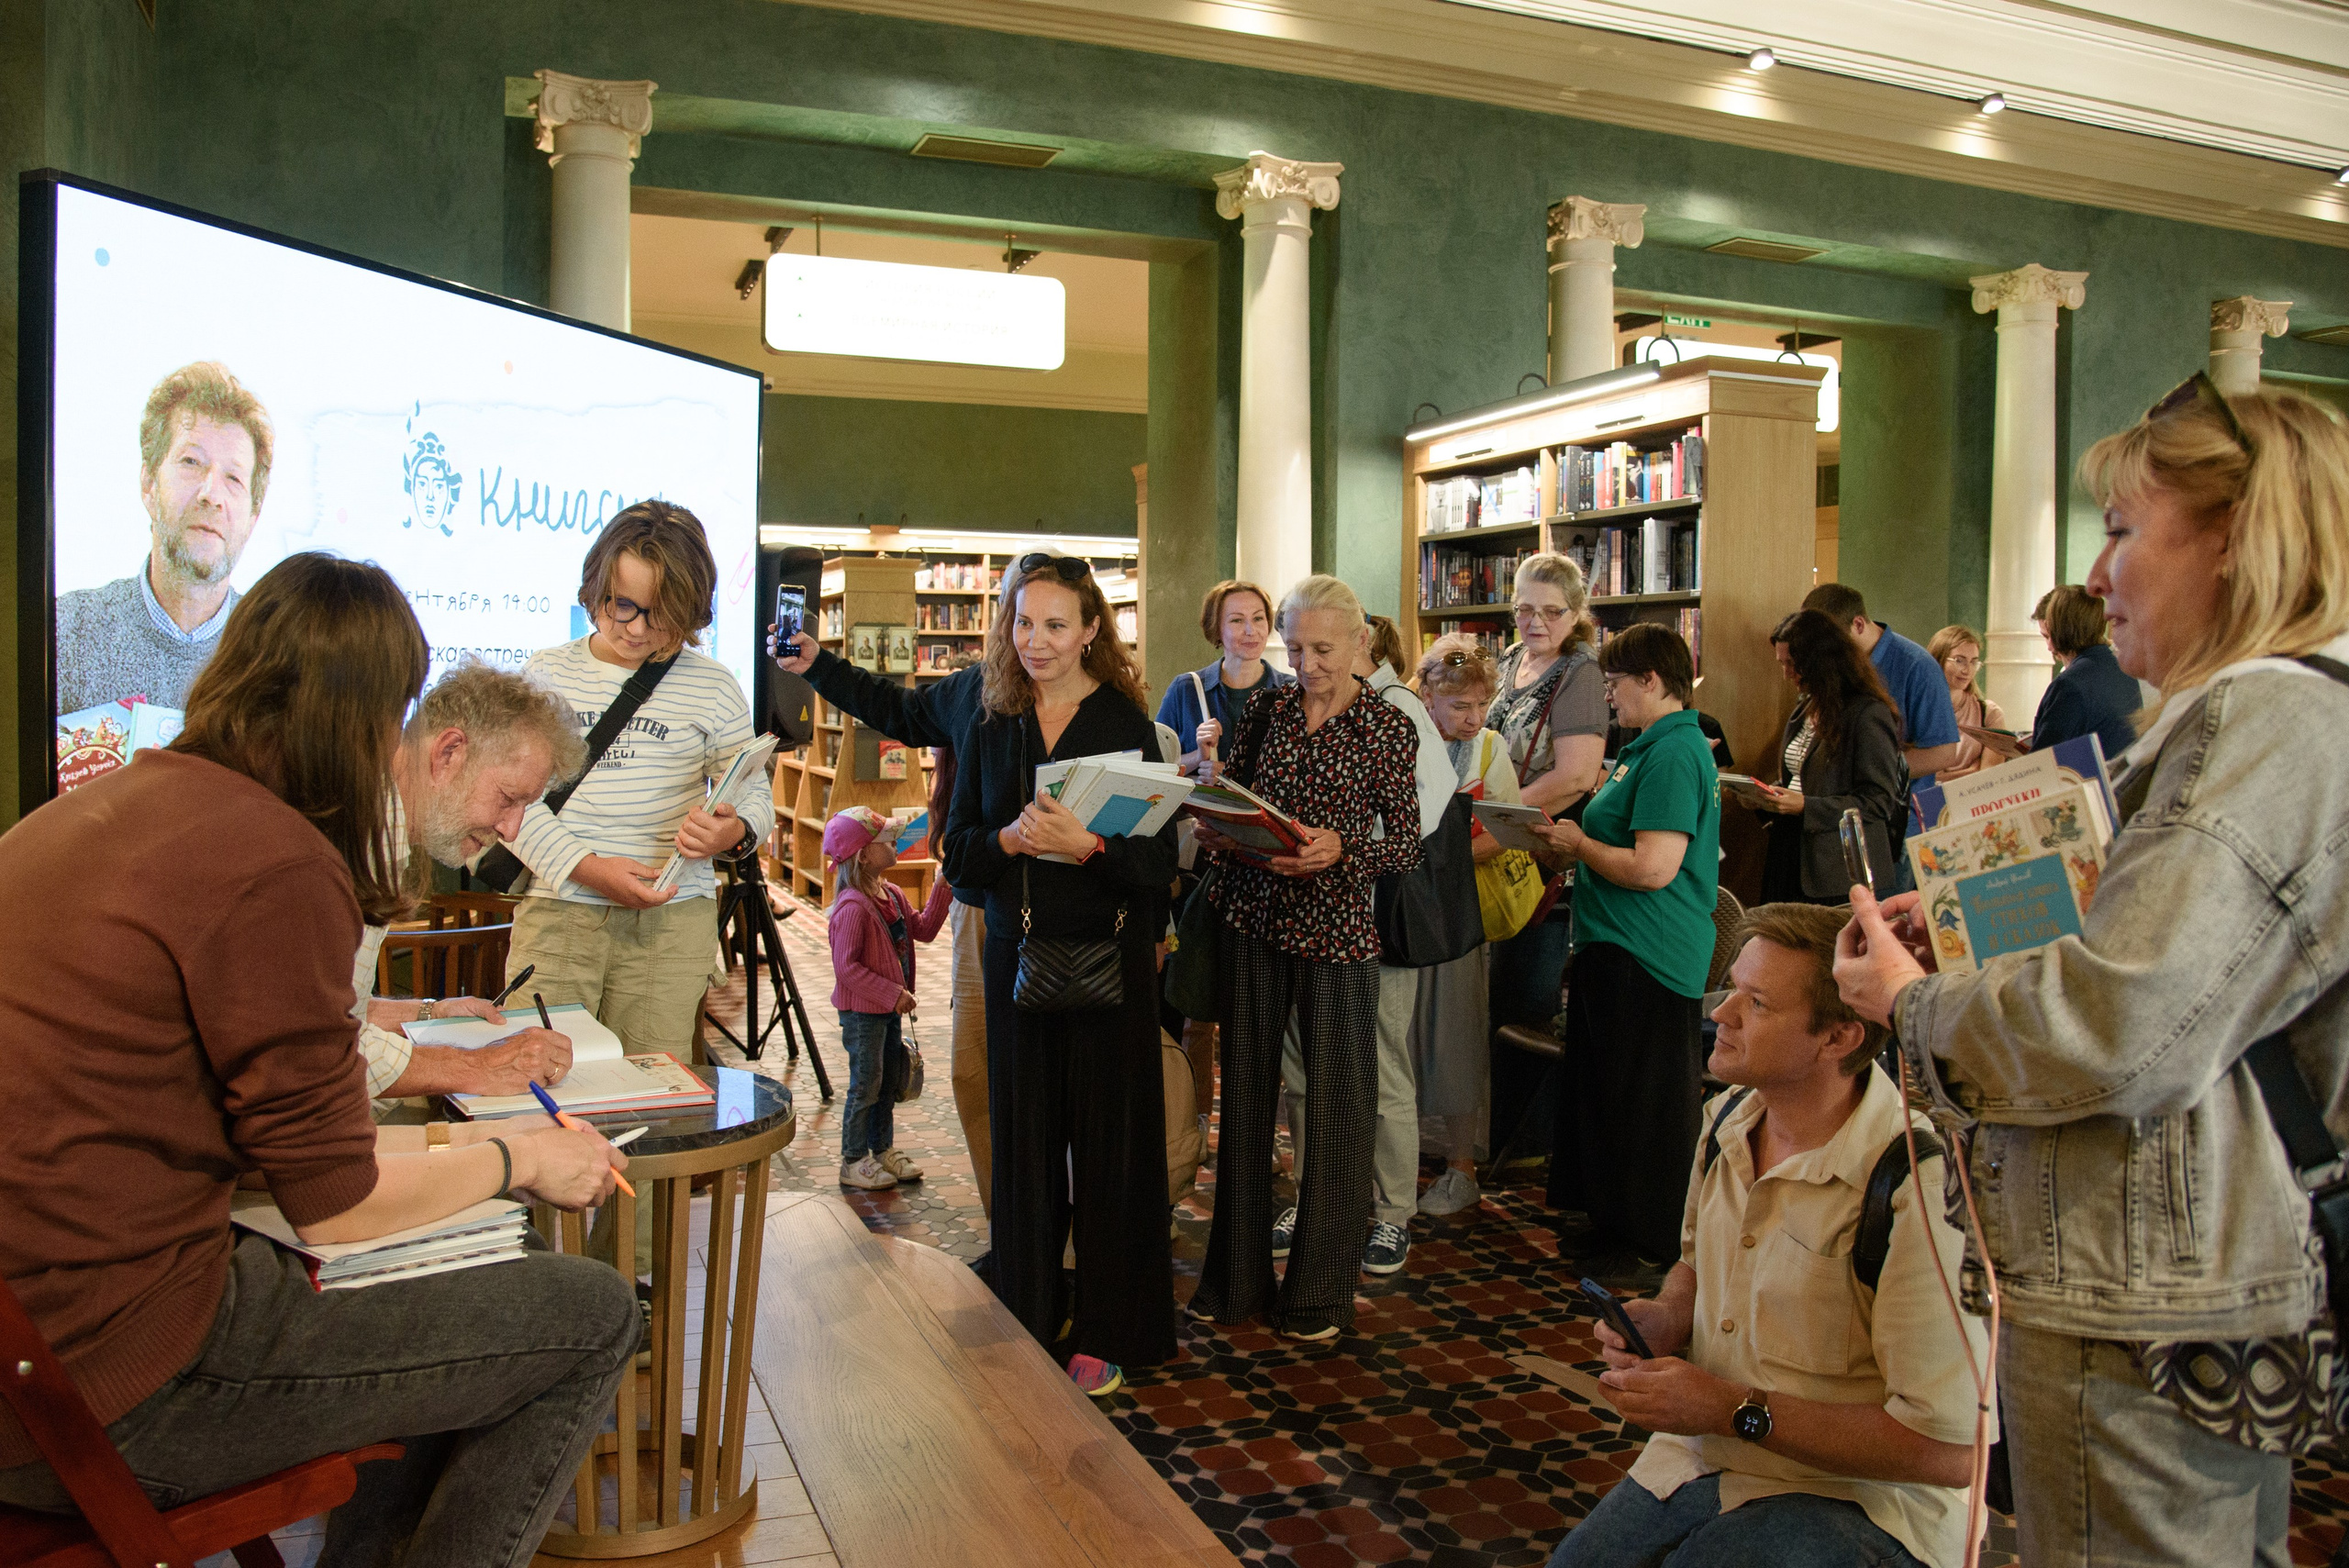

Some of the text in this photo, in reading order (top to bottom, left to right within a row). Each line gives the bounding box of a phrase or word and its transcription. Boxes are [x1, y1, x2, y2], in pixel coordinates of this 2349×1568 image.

[429, 646, 535, 667] ская встреч
[575, 710, 596, 727] KE
[627, 717, 670, 741] ETTER
